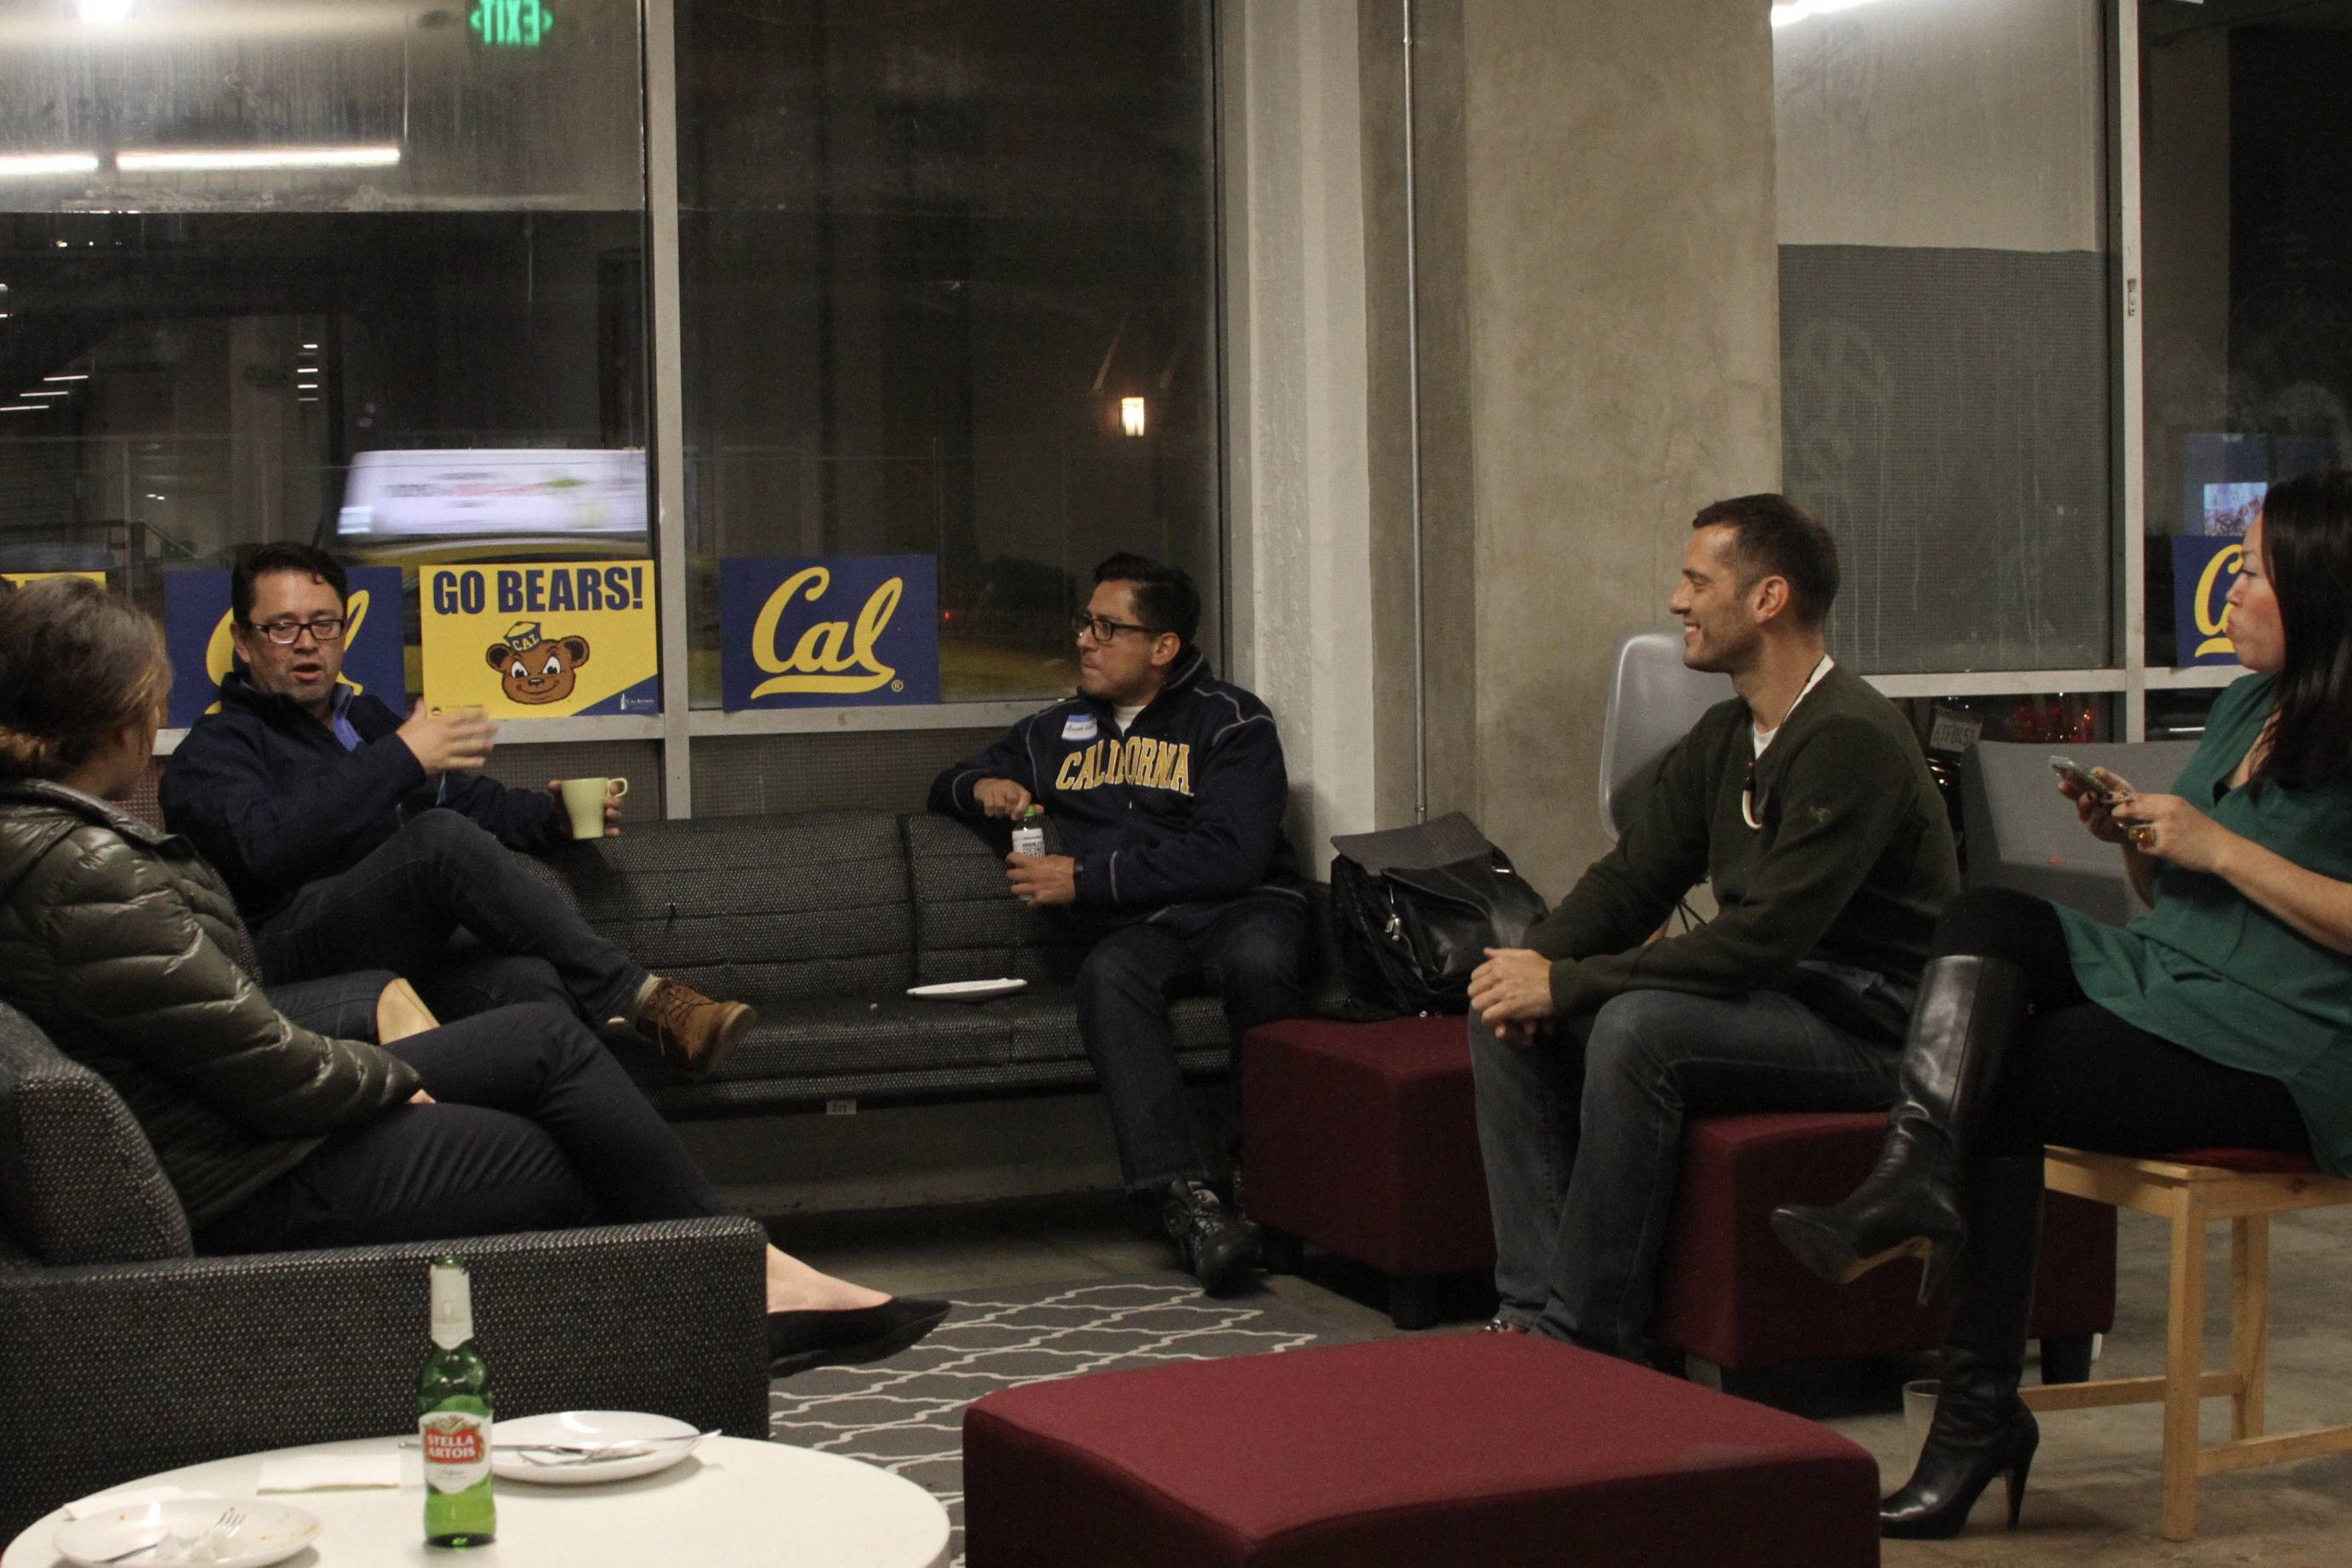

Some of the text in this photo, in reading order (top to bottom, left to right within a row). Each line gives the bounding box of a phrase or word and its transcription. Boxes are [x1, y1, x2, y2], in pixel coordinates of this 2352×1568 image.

[433, 567, 643, 615] GO BEARS!
[751, 566, 904, 699] Cal
[512, 634, 539, 651] CAL
[427, 1434, 475, 1446] STELLA
[428, 1447, 476, 1459] ARTOIS
